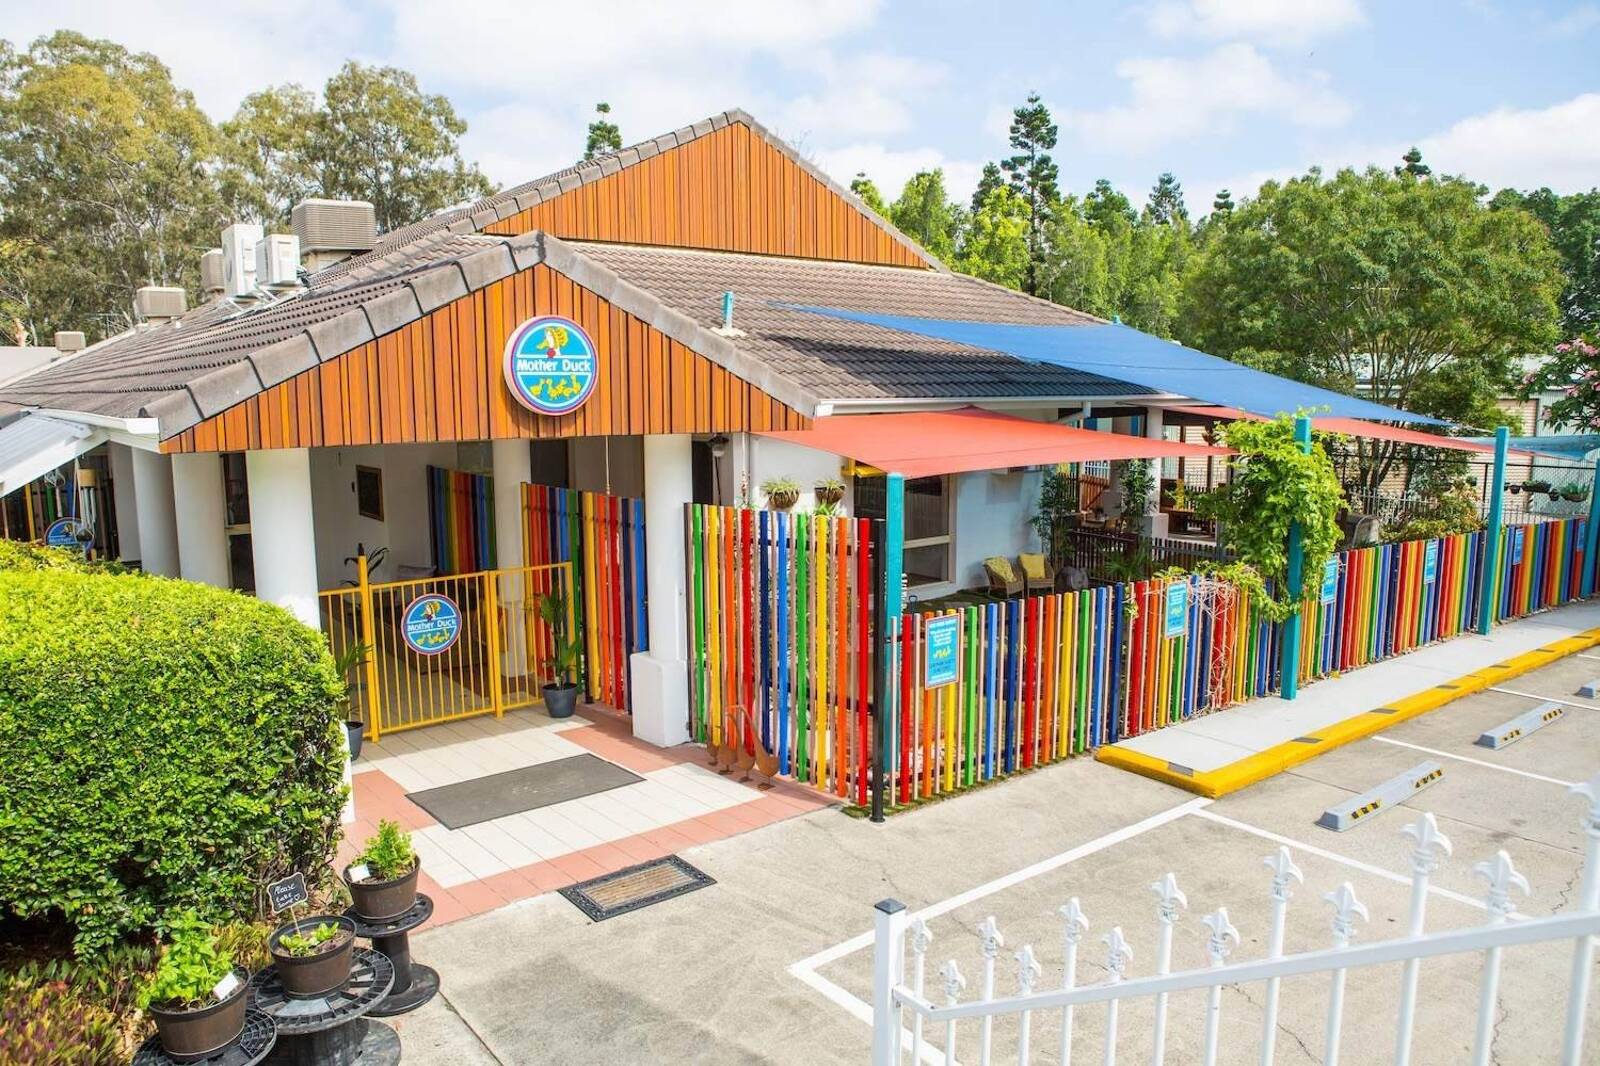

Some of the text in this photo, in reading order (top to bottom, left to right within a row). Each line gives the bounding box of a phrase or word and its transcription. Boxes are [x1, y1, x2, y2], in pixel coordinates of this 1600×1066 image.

[517, 359, 591, 371] Mother Duck
[407, 618, 456, 632] Mother Duck
